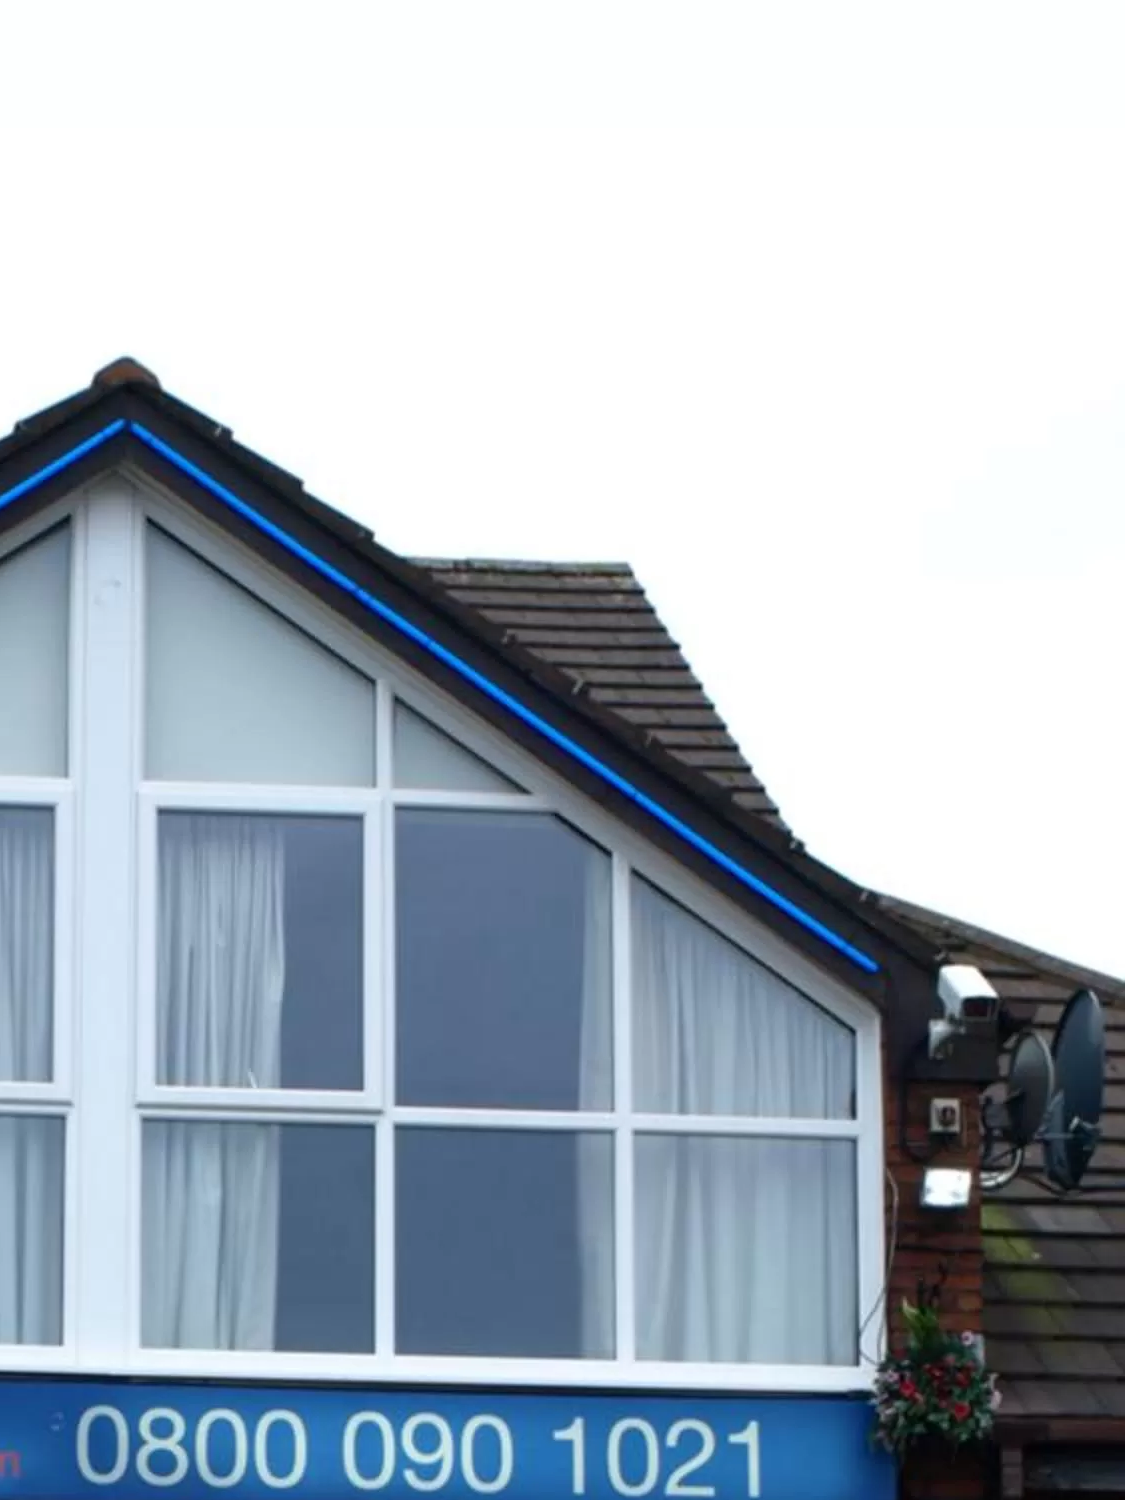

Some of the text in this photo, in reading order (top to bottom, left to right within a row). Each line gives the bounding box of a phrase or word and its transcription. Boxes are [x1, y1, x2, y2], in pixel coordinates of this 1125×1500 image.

[76, 1404, 762, 1498] 0800 090 1021
